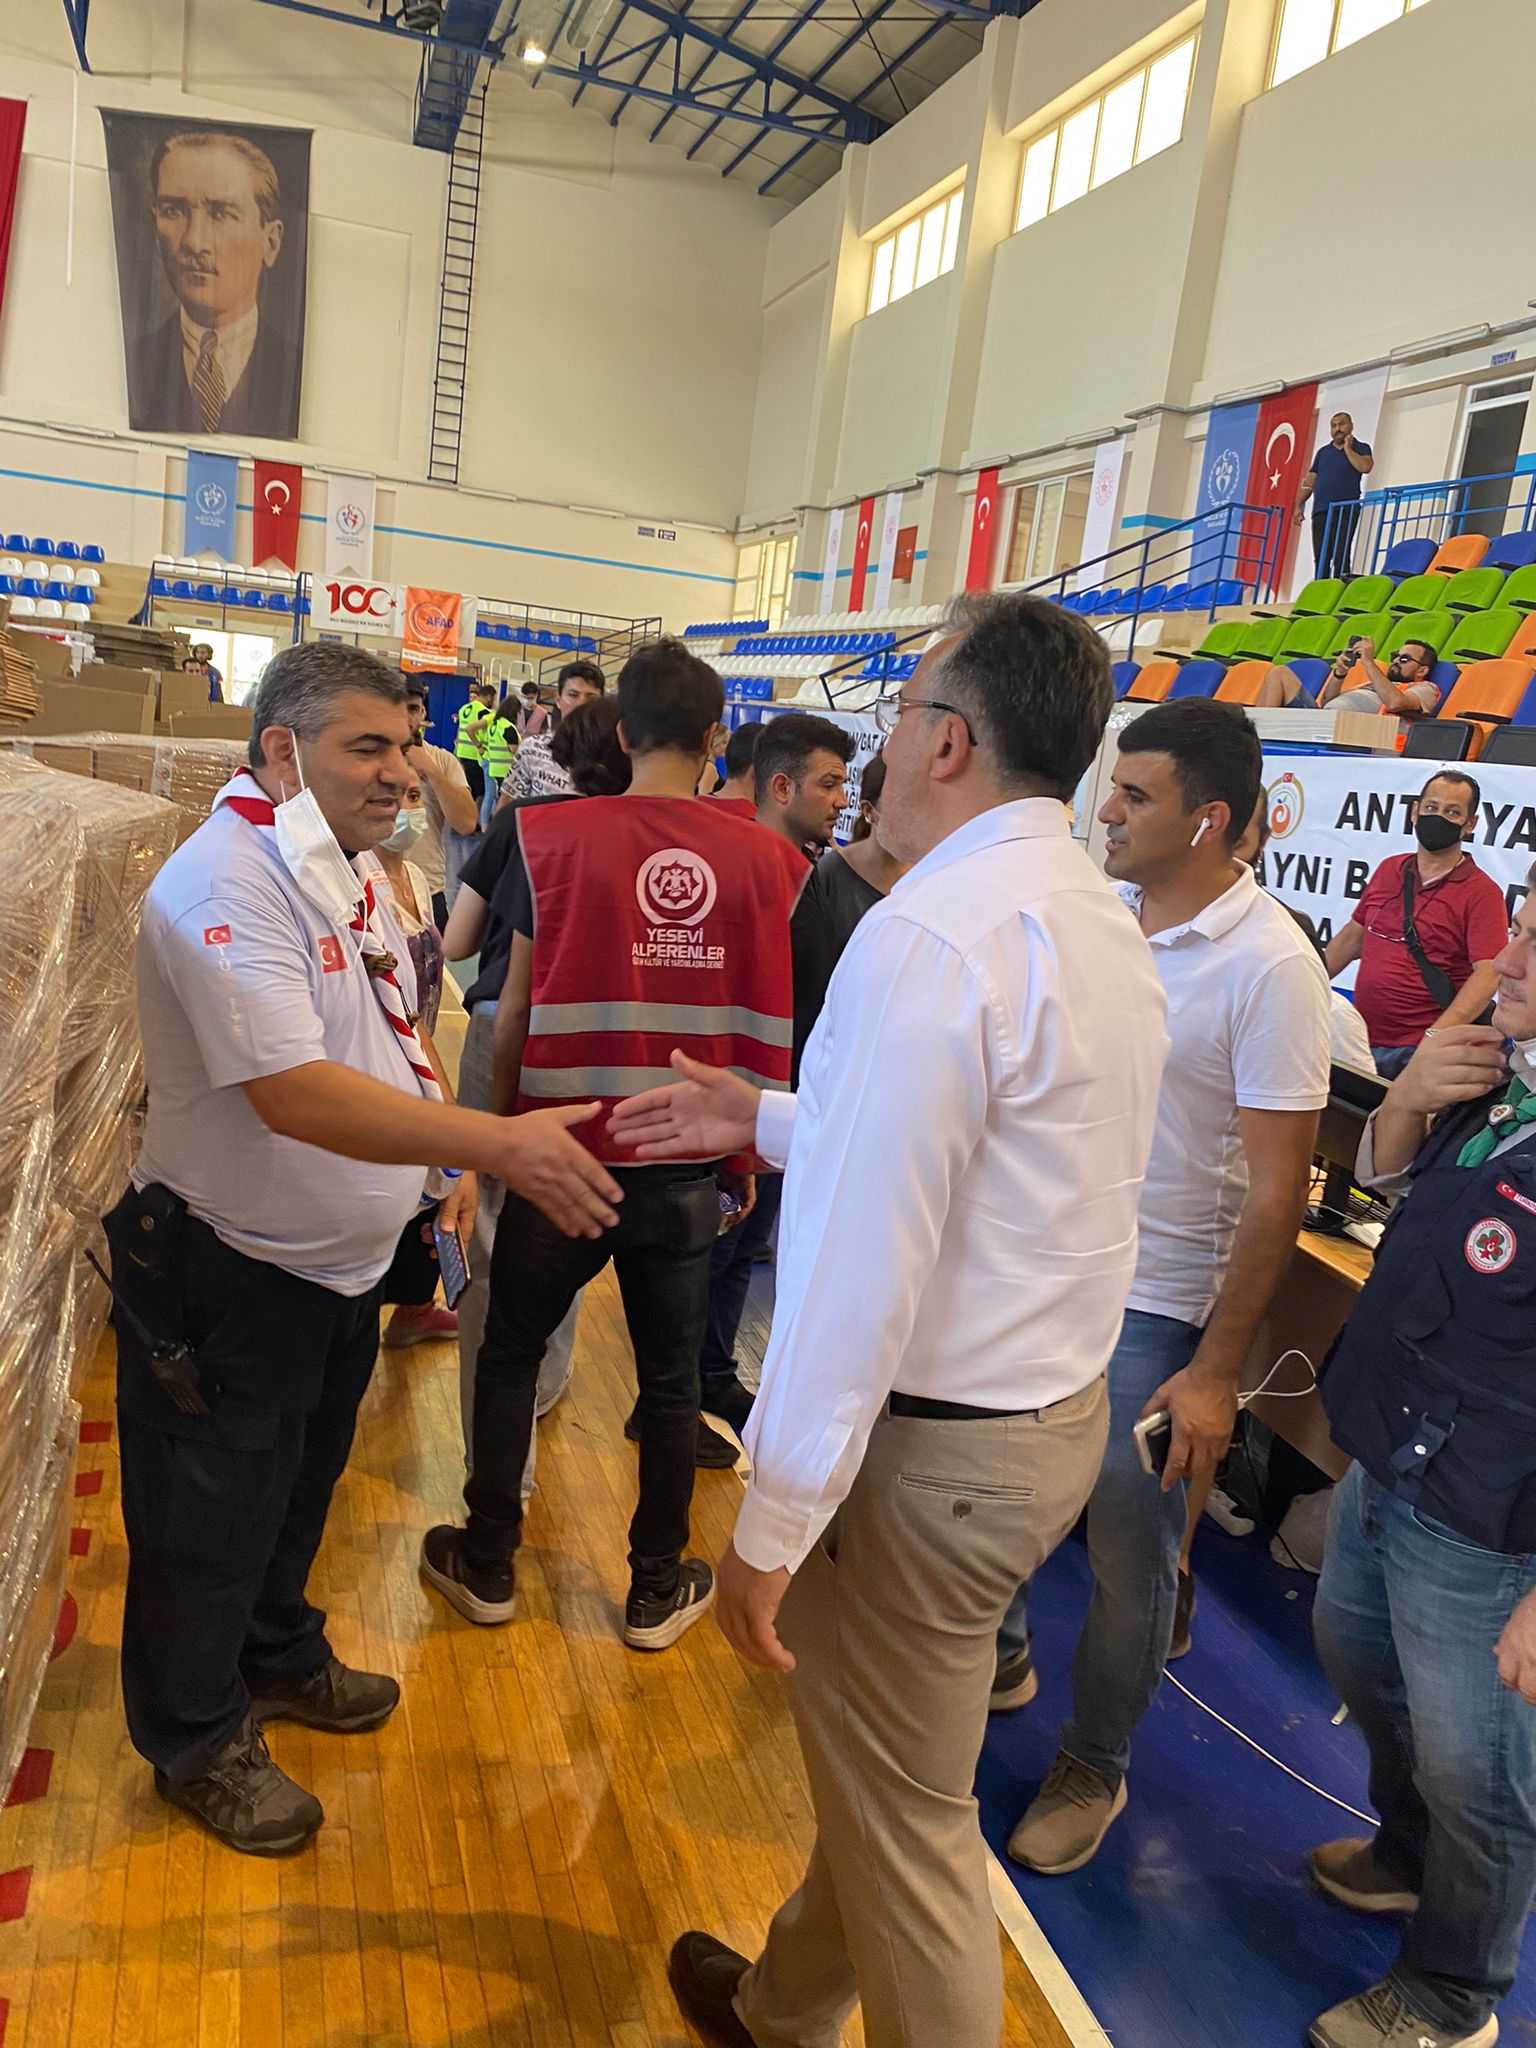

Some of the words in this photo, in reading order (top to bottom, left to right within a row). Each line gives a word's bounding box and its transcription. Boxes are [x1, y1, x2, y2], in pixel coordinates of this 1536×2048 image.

[326, 582, 391, 616] 100
[426, 615, 454, 629] AFAD
[539, 771, 569, 789] WHAT
[1335, 791, 1536, 853] ANTYA
[632, 942, 725, 960] ALPERENLER
